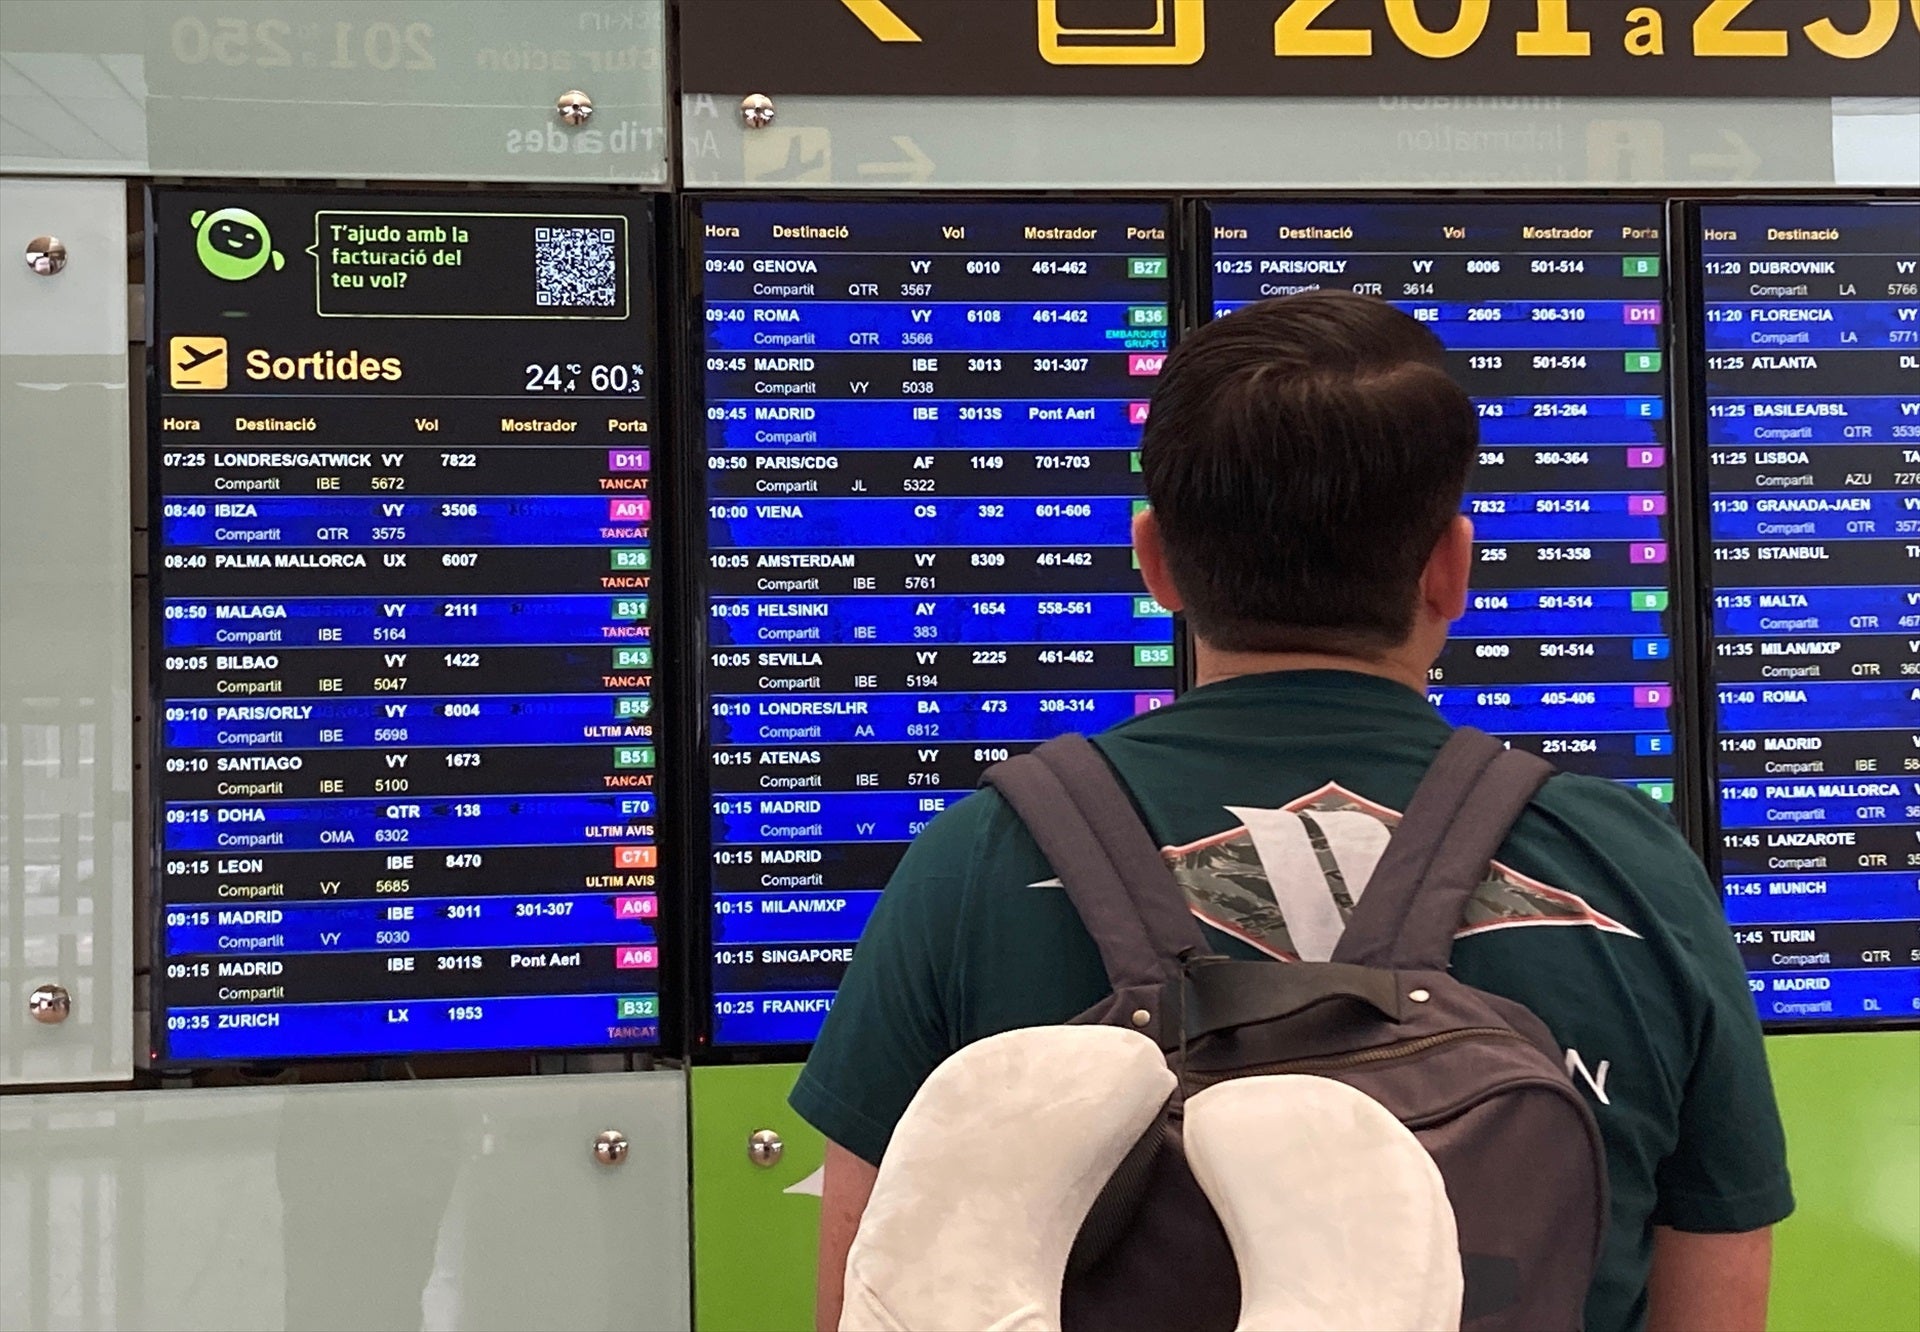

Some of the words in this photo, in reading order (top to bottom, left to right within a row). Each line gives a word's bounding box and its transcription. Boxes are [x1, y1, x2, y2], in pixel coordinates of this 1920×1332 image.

[1624, 6, 1665, 55] a
[407, 227, 446, 242] amb
[453, 227, 468, 242] la
[706, 225, 739, 237] Hora
[774, 226, 848, 238] Destinació
[943, 227, 964, 238] Vol
[1025, 227, 1097, 239] Mostrador
[1128, 228, 1164, 239] Porta
[1705, 229, 1736, 240] Hora
[1768, 229, 1839, 240] Destinació
[332, 248, 426, 265] facturació
[433, 250, 461, 265] del
[706, 260, 744, 272] 09:40
[753, 260, 817, 272] GENOVA
[911, 261, 931, 273] VY
[967, 261, 1000, 273] 6010
[1032, 262, 1086, 273] 461-462
[1135, 262, 1161, 274] B27
[1215, 261, 1252, 273] 10:25
[1261, 261, 1347, 273] PARIS/ORLY
[1413, 261, 1433, 273] VY
[1467, 261, 1500, 272] 8006
[1531, 261, 1584, 272] 501-514
[1638, 261, 1647, 272] B
[1706, 262, 1740, 274] 11:20
[1750, 262, 1835, 274] DUBROVNIK
[1897, 262, 1916, 273] VY
[332, 273, 363, 287] teu
[370, 272, 407, 288] vol?
[754, 283, 814, 297] Compartit
[849, 284, 878, 295] QTR
[901, 284, 931, 295] 3567
[1750, 285, 1807, 297] Compartit
[1840, 284, 1856, 295] LA
[1888, 284, 1917, 295] 5766
[706, 309, 745, 321] 09:40
[754, 309, 799, 321] ROMA
[911, 310, 931, 322] VY
[968, 310, 1000, 322] 6108
[1033, 310, 1087, 322] 461-462
[1135, 310, 1162, 322] B36
[1468, 309, 1501, 321] 2605
[1532, 309, 1585, 320] 306-310
[1631, 309, 1655, 320] D11
[247, 350, 401, 380] Sortides
[1708, 357, 1744, 369] 11:25
[1752, 357, 1817, 369] ATLANTA
[164, 418, 200, 430] Hora
[236, 418, 316, 430] Destinació
[415, 419, 438, 431] Vol
[502, 419, 577, 431] Mostrador
[609, 420, 647, 431] Porta
[164, 454, 205, 466] 07:25
[215, 454, 371, 466] LONDRES/GATWICK
[382, 454, 403, 466] VY
[441, 454, 476, 466] 7822
[617, 455, 642, 466] D11
[708, 457, 747, 469] 09:50
[756, 457, 838, 469] PARIS/CDG
[914, 456, 934, 468] AF
[971, 456, 1003, 468] 1149
[1035, 456, 1090, 468] 701-703
[1711, 453, 1746, 464] 11:25
[1755, 452, 1809, 464] LISBOA
[215, 478, 279, 492] Compartit
[317, 478, 340, 489] IBE
[372, 478, 404, 489] 5672
[599, 479, 648, 489] TANCAT
[164, 504, 206, 517] 08:40
[215, 504, 257, 517] IBIZA
[383, 504, 404, 516] VY
[442, 504, 477, 516] 3506
[617, 504, 643, 515] A01
[1713, 500, 1748, 512] 11:30
[1757, 499, 1870, 511] GRANADA-JAEN
[215, 528, 280, 542] Compartit
[317, 528, 348, 539] QTR
[372, 528, 405, 539] 3575
[600, 528, 649, 538] TANCAT
[165, 555, 206, 568] 08:40
[216, 555, 271, 567] PALMA
[275, 554, 366, 567] MALLORCA
[384, 554, 406, 567] UX
[442, 554, 477, 566] 6007
[618, 553, 646, 565] B28
[710, 555, 748, 567] 10:05
[757, 555, 854, 567] AMSTERDAM
[915, 554, 936, 566] VY
[971, 554, 1004, 566] 8309
[1037, 553, 1092, 565] 461-462
[601, 577, 650, 587] TANCAT
[165, 606, 206, 619] 08:50
[216, 605, 286, 618] MALAGA
[384, 604, 406, 617] VY
[445, 604, 476, 616] 2111
[619, 602, 646, 618] B31
[711, 654, 750, 666] 10:05
[759, 653, 822, 665] SEVILLA
[916, 652, 937, 664] VY
[973, 651, 1006, 663] 2225
[1038, 650, 1093, 663] 461-462
[1140, 650, 1169, 664] B35
[1478, 693, 1510, 705] 6150
[1541, 692, 1595, 704] 405-406
[1649, 691, 1659, 702] D
[1722, 787, 1758, 799] 11:40
[1766, 786, 1816, 798] PALMA
[1819, 784, 1900, 797] MALLORCA
[167, 809, 208, 823] 09:15
[217, 807, 266, 823] DOHA
[387, 805, 420, 819] QTR
[455, 804, 480, 817] 138
[622, 801, 649, 813] E70
[218, 832, 283, 847] Compartit
[320, 831, 354, 843] OMA
[375, 829, 408, 842] 6302
[586, 826, 622, 837] ULTIM
[626, 826, 654, 836] AVIS
[1724, 835, 1759, 847] 11:45
[1768, 833, 1855, 846] LANZAROTE
[167, 861, 209, 874] 09:15
[218, 860, 262, 873] LEON
[387, 856, 413, 869] IBE
[446, 854, 481, 867] 8470
[623, 850, 649, 863] C71
[1769, 857, 1826, 870] Compartit
[1859, 855, 1887, 866] QTR
[715, 901, 753, 914] 10:15
[762, 899, 846, 913] MILAN/MXP
[1771, 930, 1815, 942] TURIN
[715, 951, 753, 964] 10:15
[762, 949, 852, 963] SINGAPORE
[168, 964, 209, 978] 09:15
[219, 962, 283, 976] MADRID
[388, 958, 414, 971] IBE
[438, 956, 482, 969] 3011S
[511, 954, 546, 967] Pont
[549, 953, 579, 966] Aeri
[624, 951, 652, 963] A06
